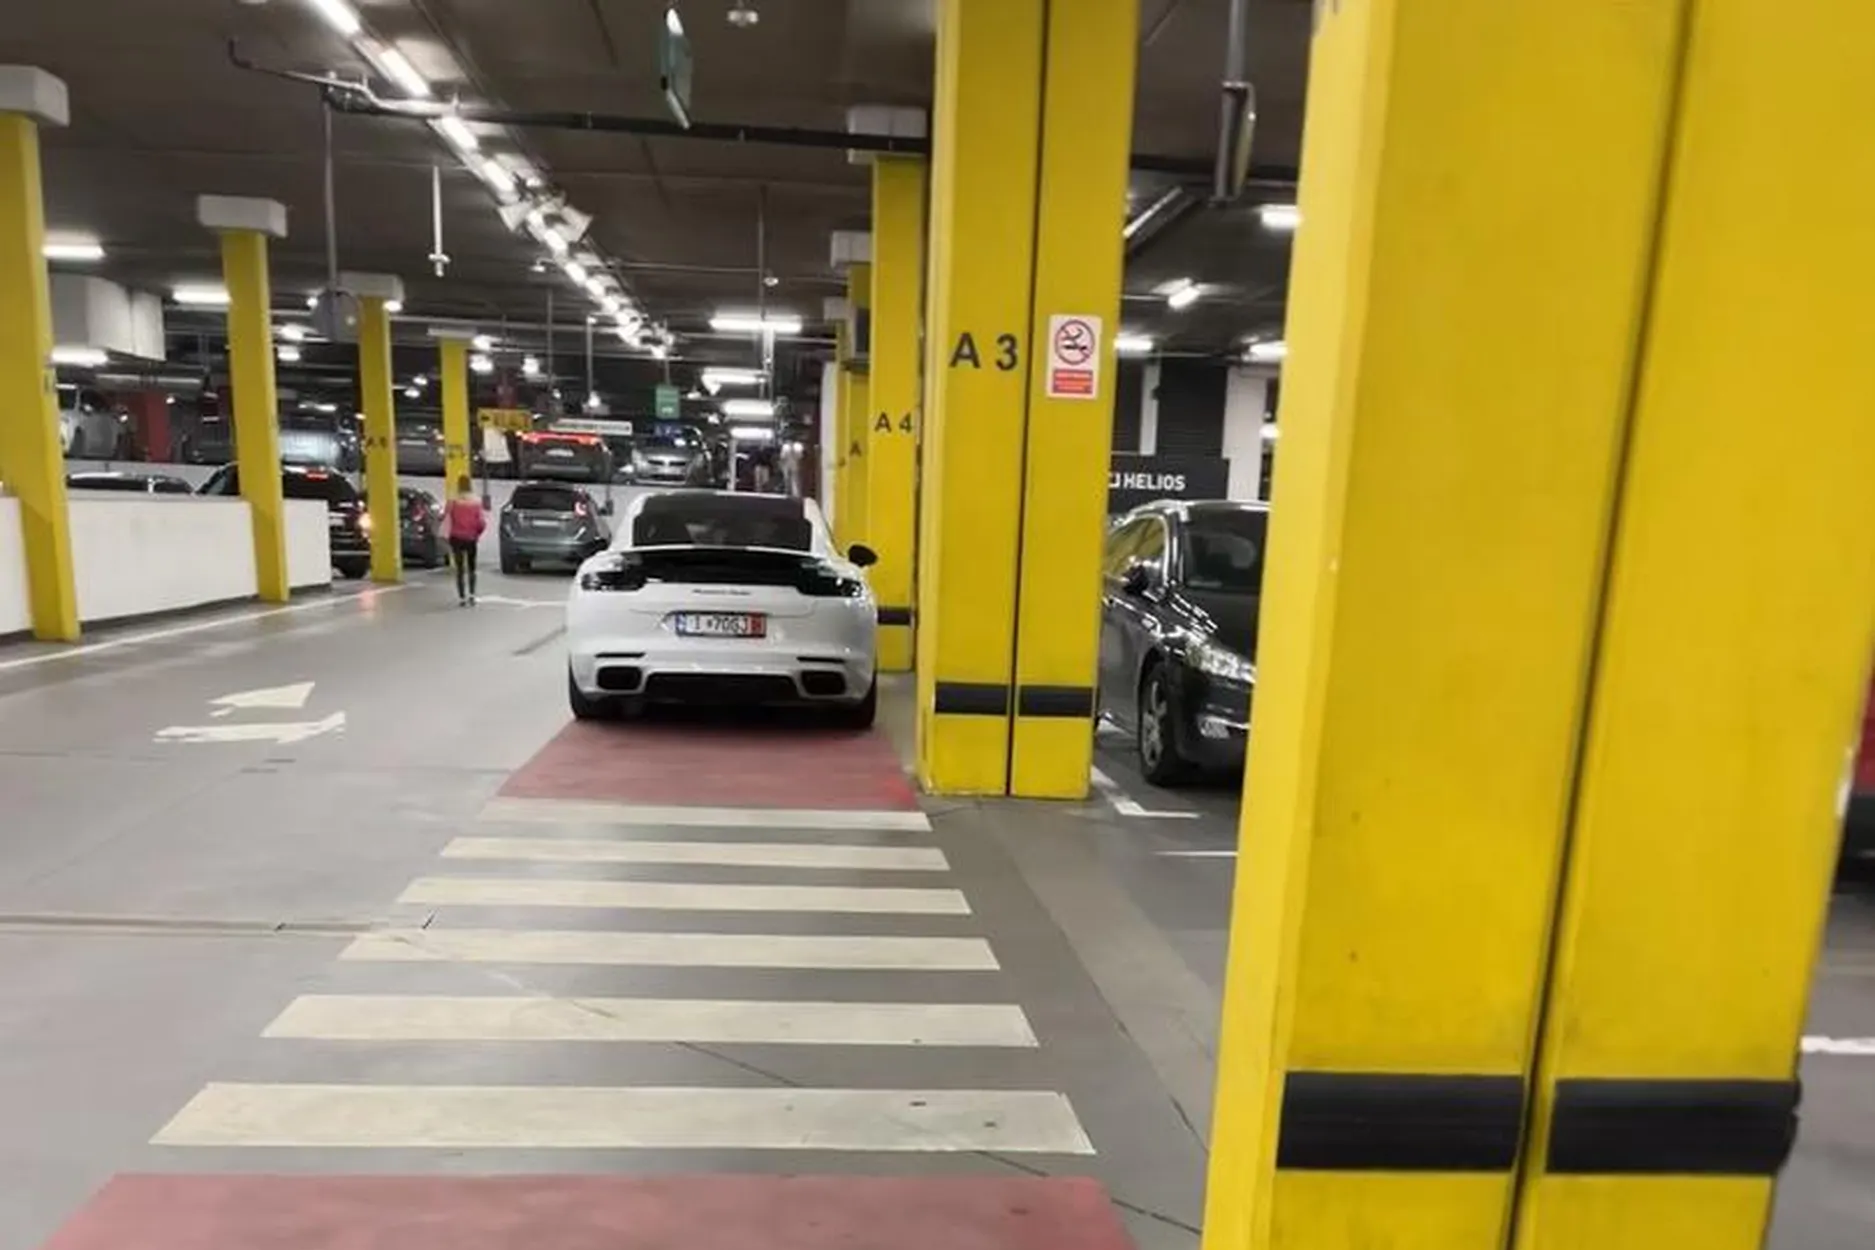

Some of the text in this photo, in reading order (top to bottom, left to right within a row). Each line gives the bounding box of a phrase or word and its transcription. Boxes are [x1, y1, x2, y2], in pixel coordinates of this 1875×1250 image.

[949, 332, 1018, 370] A 3
[874, 411, 912, 433] A 4
[1123, 472, 1186, 492] HELIOS
